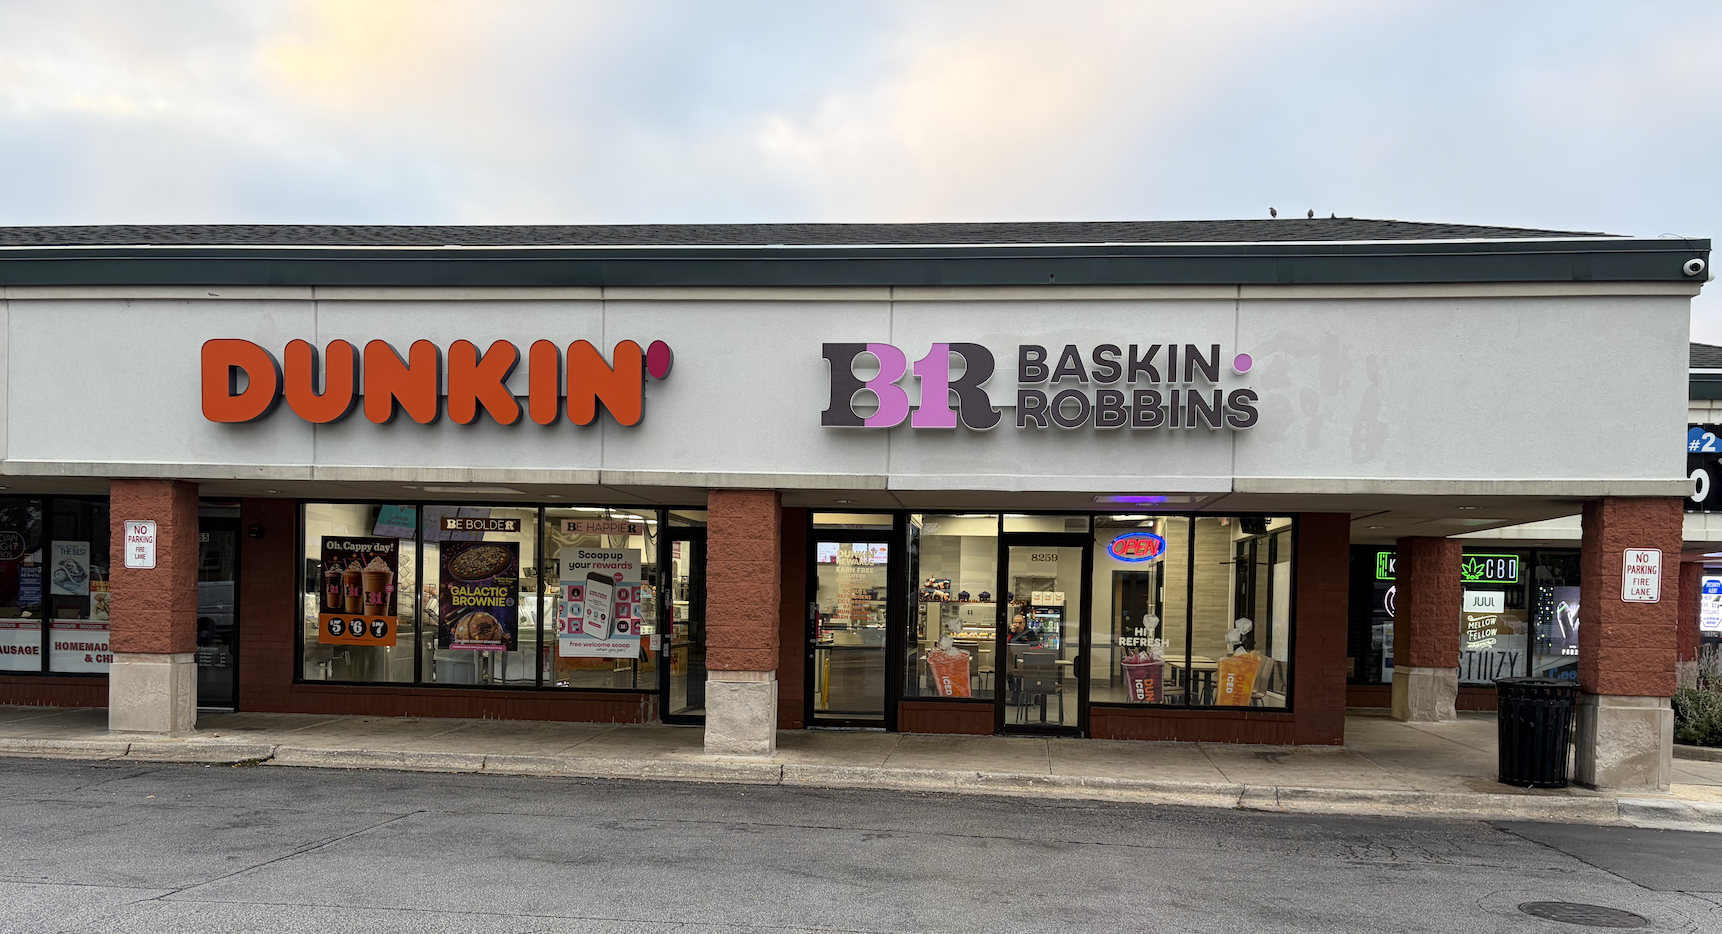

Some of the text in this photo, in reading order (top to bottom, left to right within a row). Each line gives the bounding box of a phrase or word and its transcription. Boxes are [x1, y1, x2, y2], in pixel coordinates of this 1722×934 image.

[1017, 344, 1221, 385] BASKIN
[201, 338, 673, 427] DUNKIN'
[1016, 388, 1259, 430] ROBBINS
[1688, 432, 1716, 452] #2
[134, 525, 148, 535] NO
[446, 519, 515, 530] BE BOLDER
[567, 522, 637, 533] BE HAPPIER
[128, 536, 153, 544] PARKING
[343, 541, 373, 552] Cappy
[374, 542, 394, 553] day!
[1112, 539, 1161, 556] OPEN
[578, 550, 623, 561] Scoop up
[1031, 553, 1058, 562] 8259
[1636, 554, 1649, 563] NO
[569, 561, 633, 570] your rewards
[1486, 559, 1516, 579] CBD
[1627, 565, 1657, 574] PARKING
[1633, 578, 1650, 586] FIRE
[450, 586, 508, 597] GALACTIC
[1631, 588, 1651, 596] LANE
[452, 596, 506, 607] BROWNIE
[1473, 596, 1495, 607] JUUL
[350, 620, 362, 633] $6
[1468, 618, 1496, 629] MELLOW
[1135, 627, 1154, 637] HIT
[1467, 629, 1497, 641] FELLOW
[55, 641, 109, 652] HOMEMAD
[1119, 637, 1169, 647] REFRESH
[0, 645, 39, 655] AUSAGE
[85, 654, 114, 663] & CHI
[942, 676, 953, 696] ICED
[1226, 672, 1235, 694] ICED
[1135, 679, 1145, 700] ICED
[1144, 678, 1155, 701] DUN
[1232, 674, 1246, 706] DUNK
